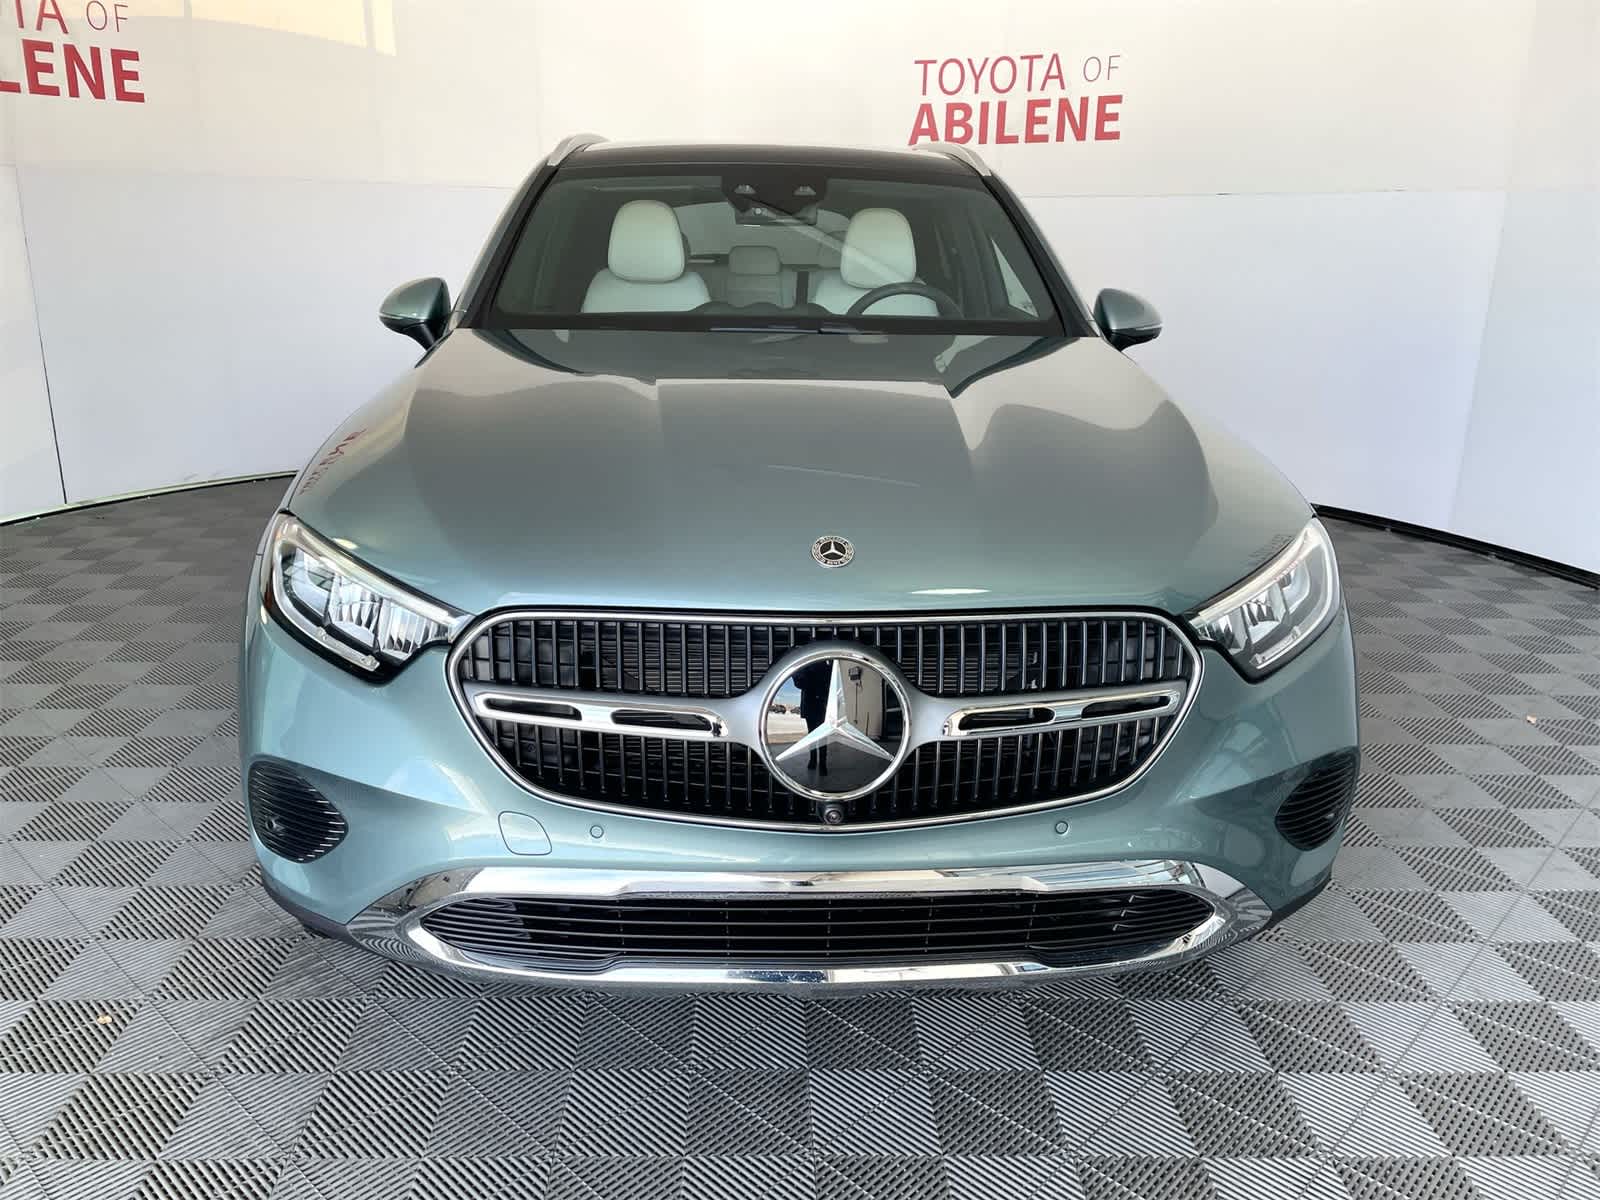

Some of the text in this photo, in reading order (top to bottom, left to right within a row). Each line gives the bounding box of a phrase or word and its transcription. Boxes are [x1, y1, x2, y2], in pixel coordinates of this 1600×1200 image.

[86, 0, 129, 32] OF
[914, 53, 1121, 96] TOYOTA OF
[907, 94, 1123, 146] ABILENE
